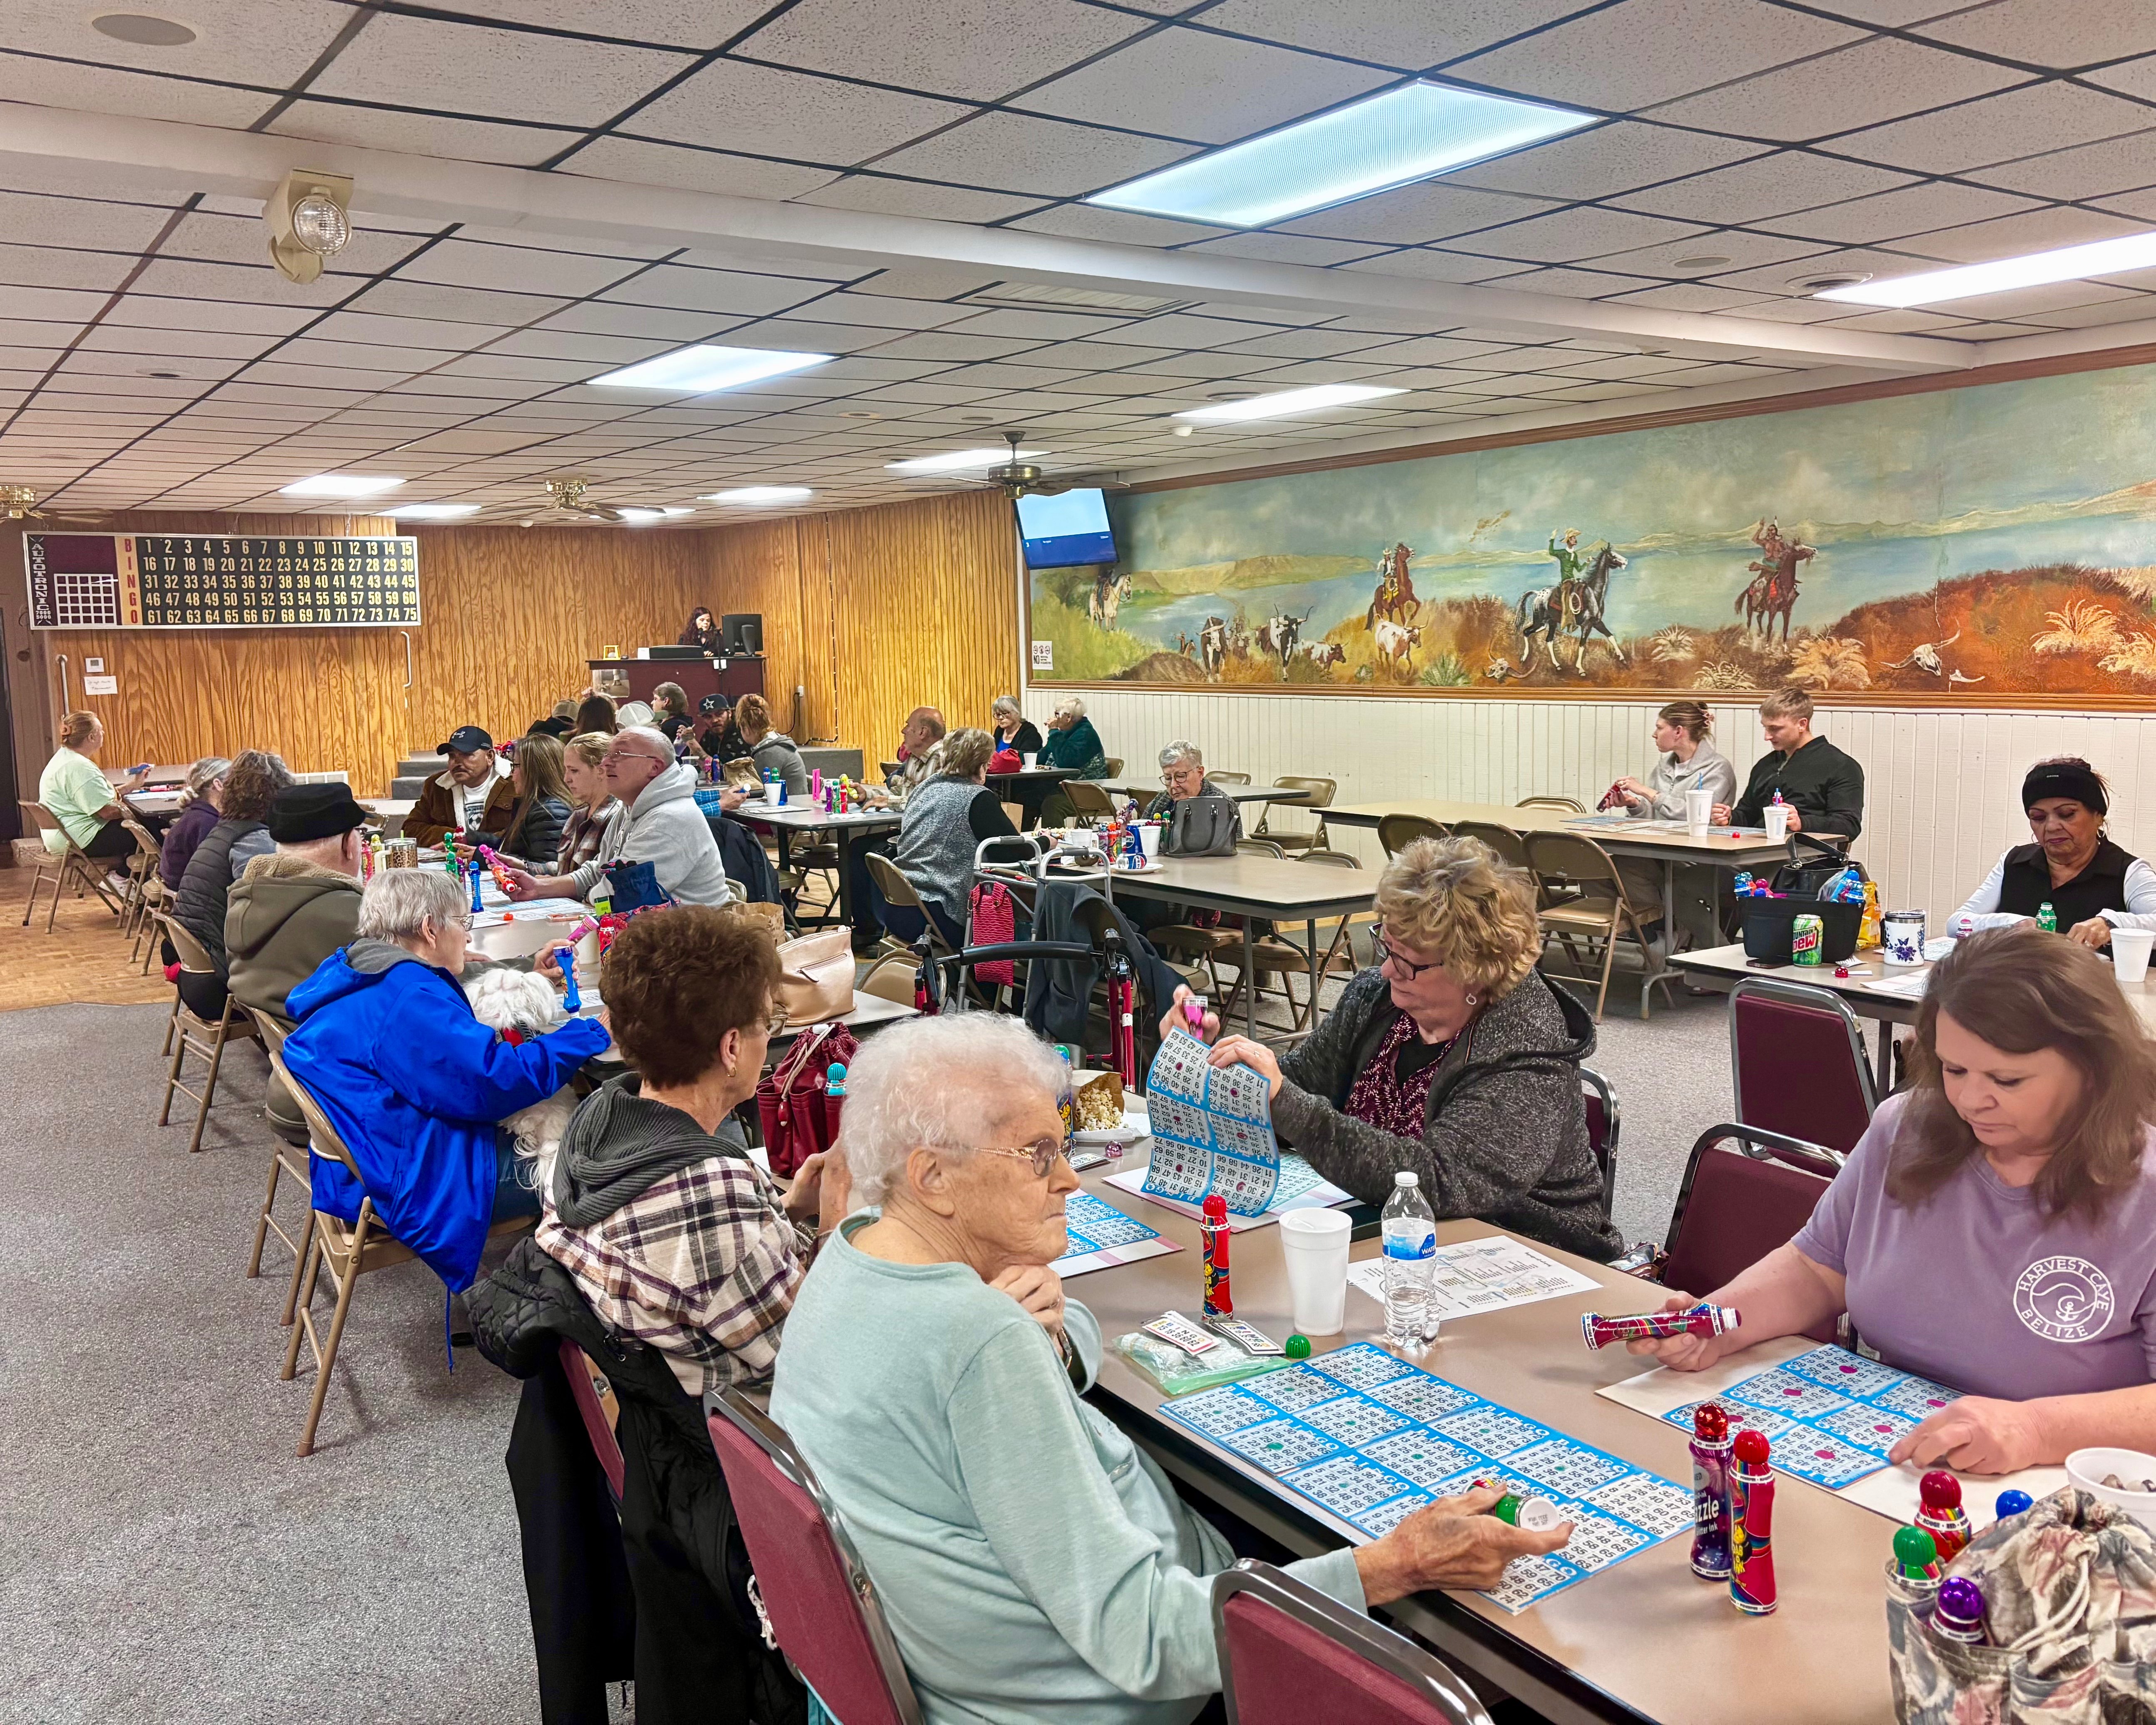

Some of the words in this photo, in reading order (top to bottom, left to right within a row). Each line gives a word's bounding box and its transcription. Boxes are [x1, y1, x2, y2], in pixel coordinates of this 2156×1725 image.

[145, 539, 152, 553] 1
[164, 539, 172, 553] 2
[184, 539, 192, 553] 3
[204, 540, 211, 554] 4
[223, 540, 230, 554] 5
[242, 540, 249, 554] 6
[260, 541, 267, 554] 7
[279, 541, 286, 554] 8
[297, 541, 304, 554] 9
[313, 541, 325, 554] 10
[332, 541, 342, 554] 11
[349, 541, 361, 555] 12
[366, 541, 378, 555] 13
[383, 541, 395, 556] 14
[401, 542, 413, 556] 15
[143, 556, 157, 571] 16
[163, 557, 176, 571] 17
[183, 557, 196, 571] 18
[202, 557, 215, 571] 19
[220, 558, 235, 571] 20
[240, 558, 253, 571] 21
[258, 558, 272, 571] 22
[277, 558, 291, 572] 23
[295, 558, 309, 571] 24
[313, 558, 327, 571] 25
[331, 558, 345, 571] 26
[349, 558, 362, 571] 27
[366, 558, 380, 572] 28
[383, 558, 397, 572] 29
[401, 558, 414, 572] 30
[32, 543, 50, 611] AUTOTRONIC
[144, 574, 158, 588] 31
[164, 575, 179, 589] 32
[184, 575, 198, 589] 33
[202, 575, 217, 589] 34
[222, 575, 236, 588] 35
[241, 575, 255, 589] 36
[259, 575, 273, 588] 37
[279, 575, 292, 589] 38
[296, 575, 310, 588] 39
[314, 575, 329, 588] 40
[333, 575, 345, 588] 41
[349, 575, 364, 588] 42
[367, 574, 381, 588] 43
[384, 575, 398, 588] 44
[401, 575, 415, 588] 45
[145, 592, 161, 606] 46
[165, 593, 179, 606] 47
[185, 592, 200, 606] 48
[204, 592, 219, 606] 49
[224, 592, 238, 606] 50
[243, 592, 256, 606] 51
[261, 592, 275, 606] 52
[280, 592, 294, 606] 53
[298, 592, 311, 605] 54
[316, 591, 329, 605] 55
[334, 591, 347, 605] 56
[351, 591, 364, 605] 57
[368, 591, 382, 605] 58
[385, 591, 399, 605] 59
[403, 591, 416, 605] 60
[148, 610, 161, 623] 61
[167, 610, 182, 623] 62
[186, 609, 201, 623] 63
[205, 609, 220, 623] 64
[224, 609, 239, 623] 65
[244, 609, 258, 623] 66
[262, 609, 276, 623] 67
[281, 609, 295, 623] 68
[299, 608, 313, 622] 69
[317, 608, 331, 622] 70
[335, 608, 348, 621] 71
[351, 608, 366, 621] 72
[368, 608, 383, 621] 73
[386, 608, 400, 621] 74
[403, 607, 417, 621] 75
[2019, 1259, 2089, 1292] HARVEST
[2090, 1273, 2109, 1311] CAYE
[2021, 1309, 2088, 1338] BELIZE
[1561, 1486, 1576, 1495] 70
[1647, 1526, 1664, 1535] 69
[1659, 1521, 1675, 1529] 72
